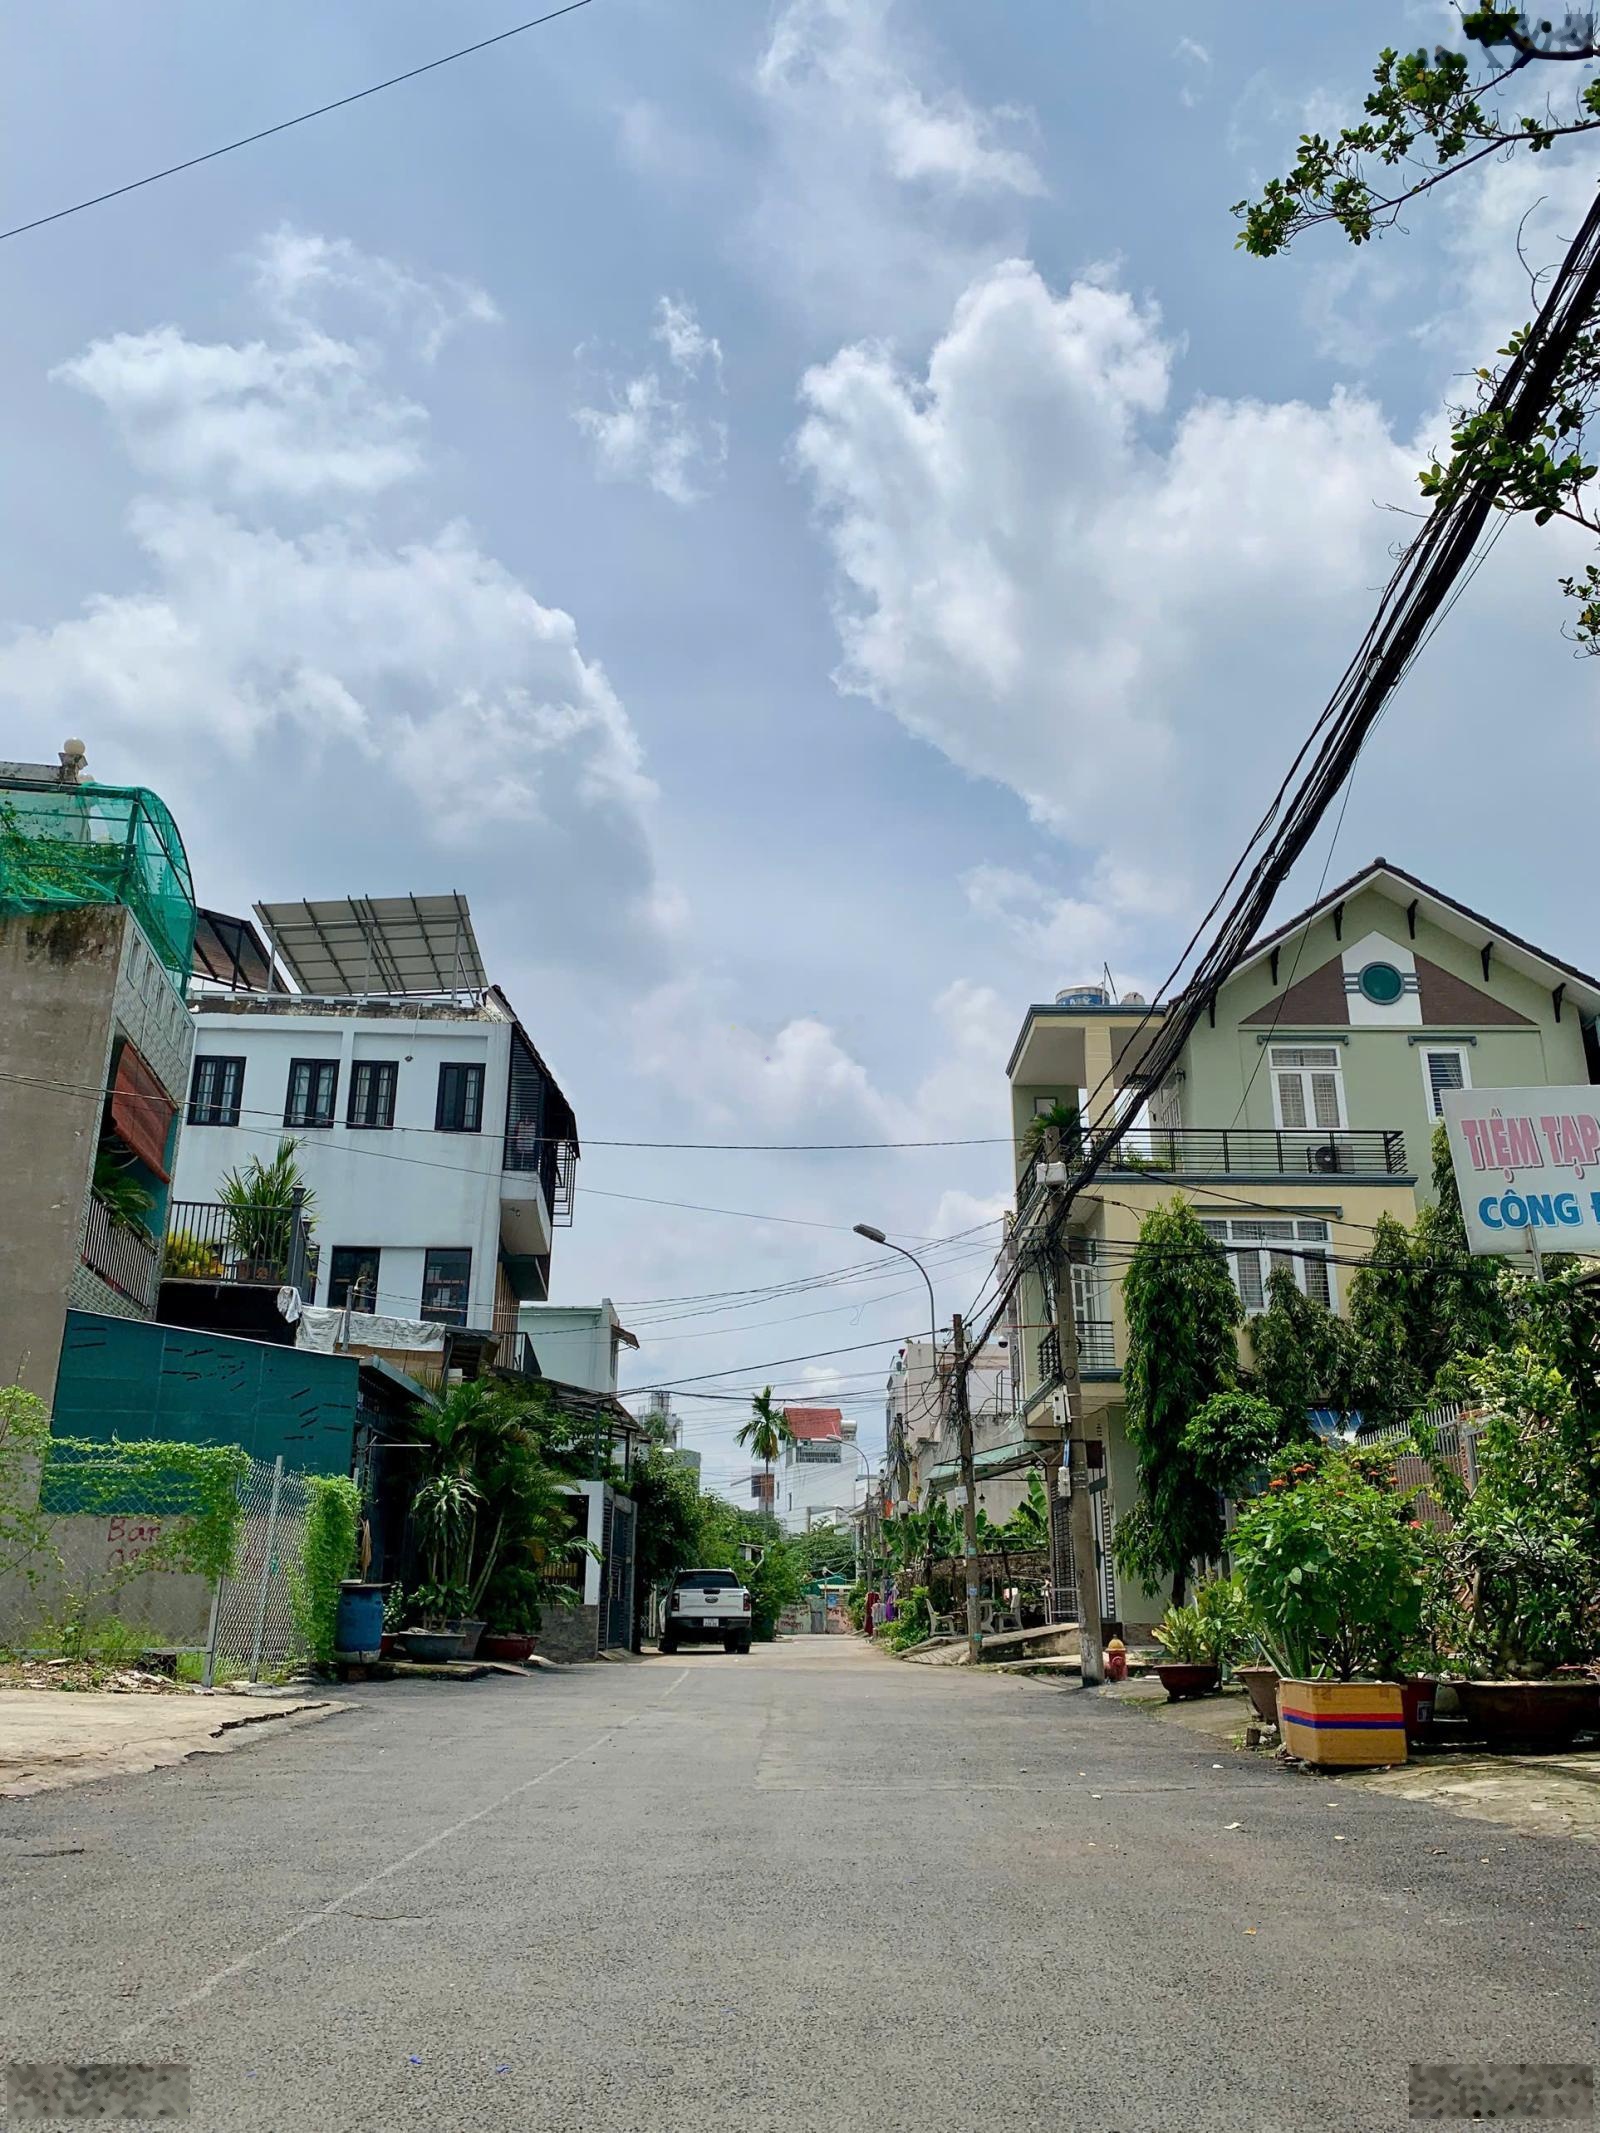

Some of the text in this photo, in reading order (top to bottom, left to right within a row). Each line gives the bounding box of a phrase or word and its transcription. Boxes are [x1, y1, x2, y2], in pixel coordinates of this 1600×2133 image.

[1461, 1108, 1600, 1182] TIỆM TẠP
[1479, 1189, 1582, 1228] CÔNG
